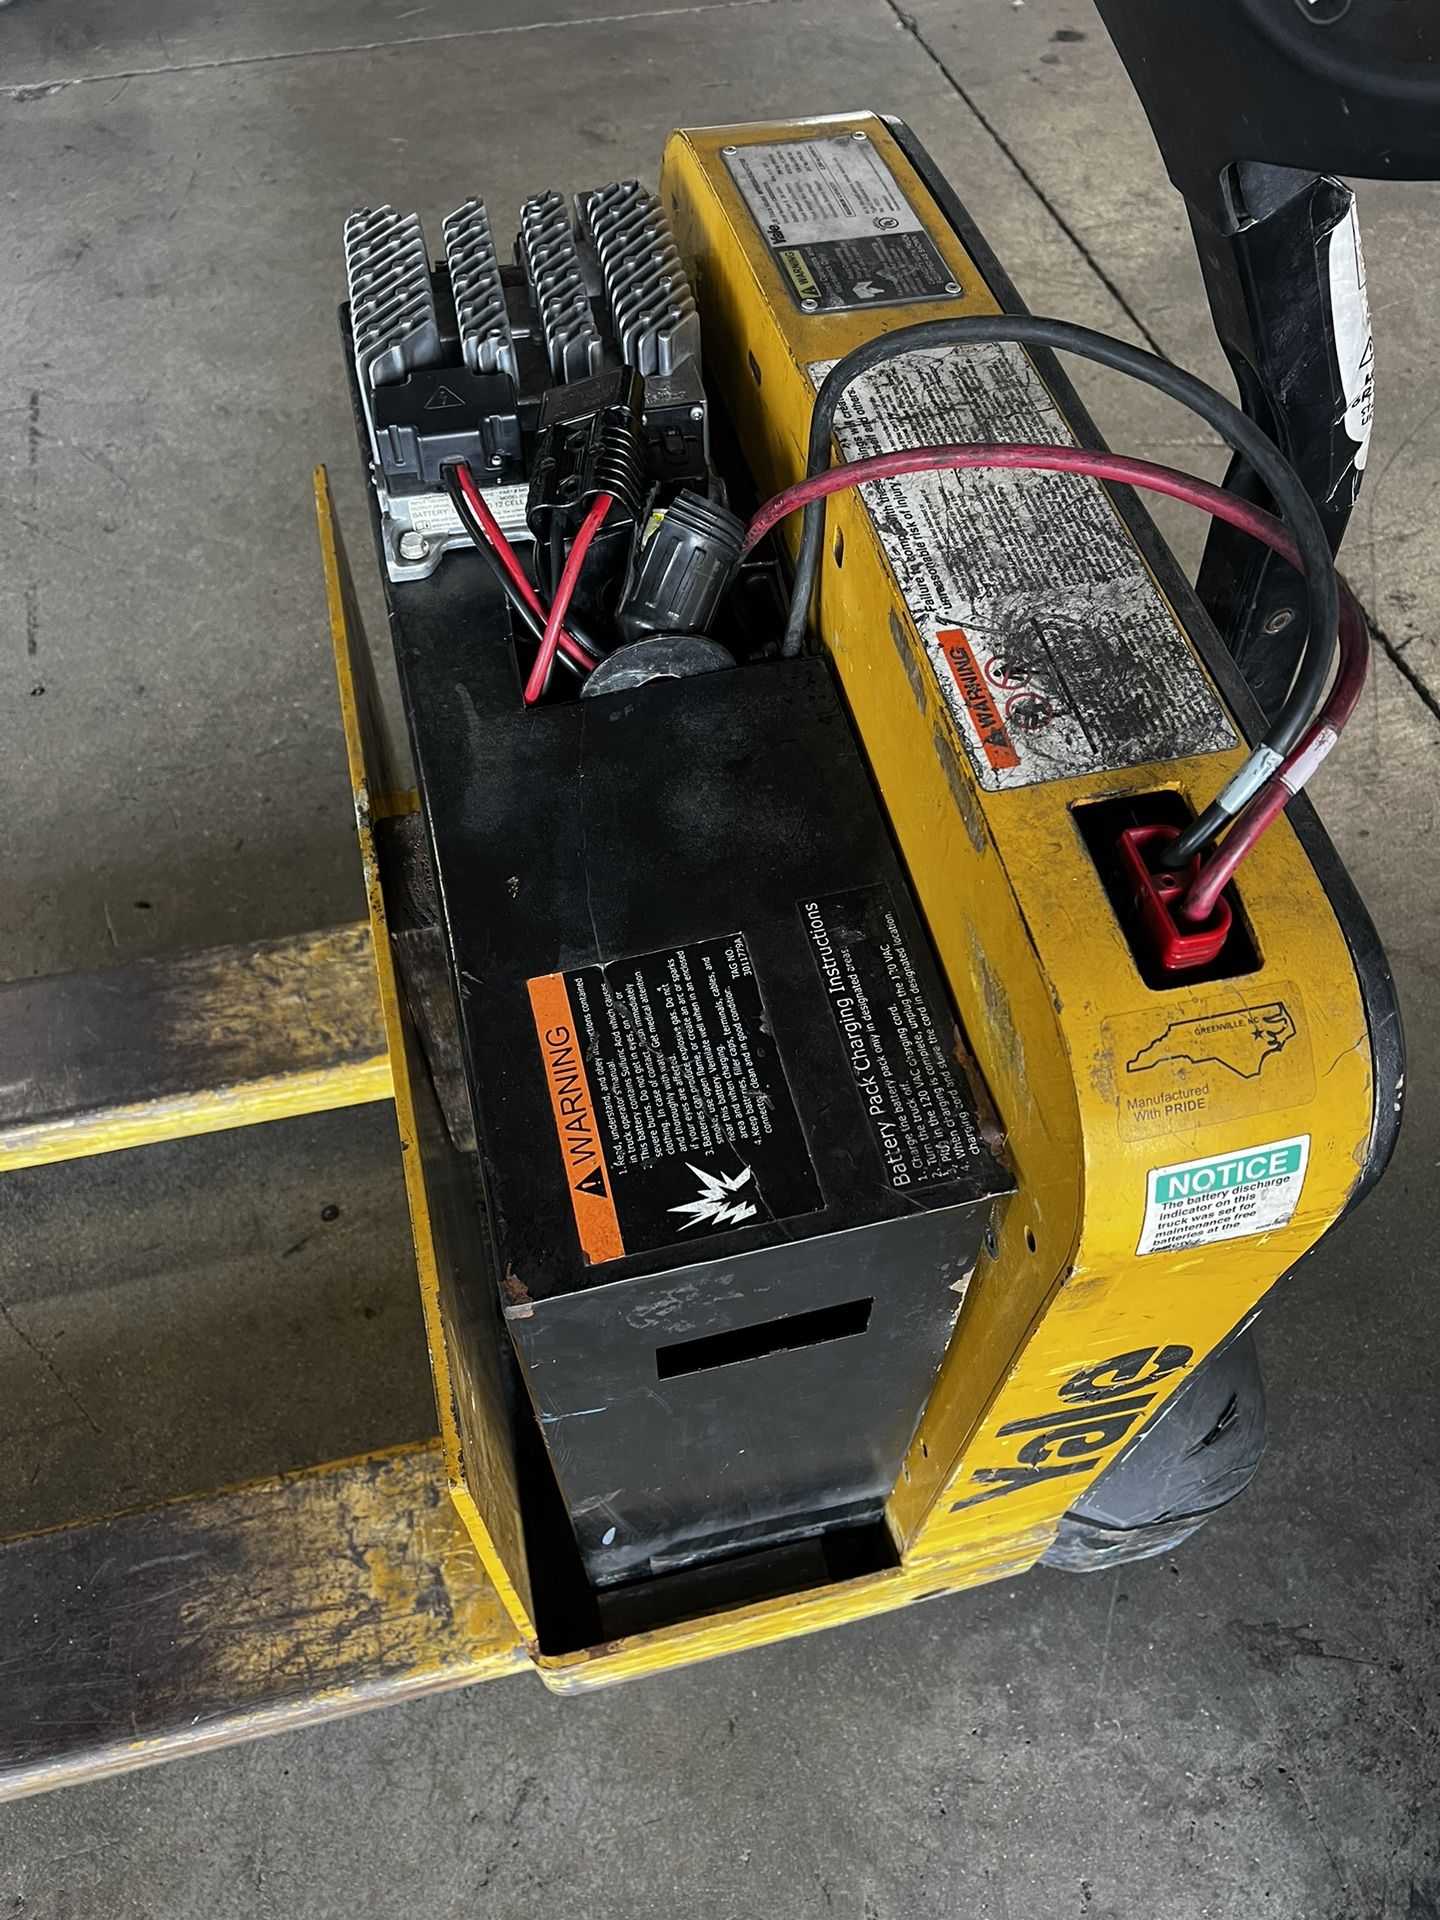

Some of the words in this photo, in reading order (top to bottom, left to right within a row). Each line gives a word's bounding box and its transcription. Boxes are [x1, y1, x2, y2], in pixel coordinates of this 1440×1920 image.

[763, 224, 787, 245] Yale
[783, 250, 809, 285] WARNING
[843, 386, 865, 415] others.
[856, 415, 874, 433] and
[886, 480, 911, 509] injury
[411, 507, 448, 519] BATTERY
[503, 496, 524, 507] CELL
[903, 520, 922, 540] risk
[911, 576, 937, 612] Failure
[947, 645, 998, 729] WARNING
[884, 911, 902, 946] location.
[733, 937, 752, 976] 3011779A
[804, 902, 845, 993] Instructions
[667, 958, 680, 982] sparks
[675, 950, 691, 980] enclosed
[701, 956, 712, 970] and
[728, 962, 740, 979] TAG
[894, 947, 919, 993] designated
[573, 977, 589, 1012] contained
[634, 970, 648, 1003] attention
[707, 971, 720, 996] cables,
[895, 982, 906, 997] the
[624, 983, 642, 1027] immediately
[676, 992, 686, 1004] arc
[847, 973, 871, 1020] designated
[605, 1008, 618, 1029] which
[641, 1004, 656, 1032] medical
[669, 1009, 681, 1025] gas.
[691, 1001, 702, 1022] when
[714, 998, 731, 1035] terminals,
[887, 1003, 902, 1025] cord.
[901, 998, 918, 1029] unplug
[916, 1006, 931, 1026] cord
[610, 1030, 622, 1046] Acid
[683, 1016, 695, 1040] create
[695, 1022, 707, 1038] well
[732, 1022, 747, 1041] good
[836, 997, 870, 1074] Charging
[1193, 1017, 1247, 1037] GREENVILLE,
[1247, 1015, 1260, 1025] NC
[625, 1030, 636, 1050] eyes,
[650, 1033, 660, 1048] Get
[673, 1026, 688, 1060] explosive
[726, 1036, 737, 1056] caps,
[594, 1057, 604, 1075] obey
[616, 1048, 630, 1076] Sulfuric
[631, 1060, 644, 1073] get
[692, 1051, 705, 1076] flame,
[701, 1039, 716, 1073] Ventilate
[716, 1043, 731, 1079] charging.
[731, 1058, 742, 1075] filler
[740, 1051, 753, 1066] and
[876, 1054, 893, 1077] pack
[596, 1076, 608, 1091] and
[635, 1074, 645, 1088] not
[660, 1073, 671, 1090] with
[700, 1077, 711, 1096] open
[712, 1074, 726, 1104] battery.
[747, 1067, 759, 1088] clean
[898, 1080, 912, 1095] off.
[909, 1068, 924, 1088] VAC
[545, 1025, 595, 1165] WARNING
[624, 1077, 638, 1109] contains
[652, 1089, 663, 1107] case
[677, 1087, 687, 1100] are
[726, 1080, 737, 1102] when
[859, 1075, 884, 1115] Pack
[885, 1079, 903, 1113] battery
[917, 1090, 932, 1107] 120
[947, 1089, 963, 1108] cord
[1126, 1082, 1209, 1111] Manufactured
[601, 1092, 619, 1140] understand,
[613, 1089, 630, 1129] operator's
[643, 1102, 655, 1128] burns.
[665, 1092, 683, 1134] thoroughly
[681, 1102, 692, 1121] eyes
[705, 1098, 715, 1113] use
[720, 1105, 730, 1121] this
[730, 1103, 742, 1118] and
[905, 1097, 922, 1122] truck
[926, 1109, 939, 1126] the
[1133, 1107, 1161, 1124] With
[1164, 1097, 1206, 1117] PRIDE
[633, 1111, 646, 1141] battery
[660, 1119, 675, 1154] clothing.
[686, 1123, 699, 1141] your
[696, 1110, 712, 1147] Batteries
[710, 1114, 724, 1144] smoke,
[724, 1123, 736, 1142] near
[737, 1120, 748, 1138] area
[748, 1115, 760, 1136] Keep
[916, 1124, 929, 1141] the
[955, 1111, 980, 1154] charging
[623, 1130, 635, 1153] truck
[639, 1142, 649, 1161] This
[649, 1129, 663, 1157] severe
[675, 1136, 687, 1151] and
[877, 1121, 910, 1186] Battery
[904, 1133, 923, 1168] Charge
[949, 1129, 965, 1159] When
[923, 1142, 937, 1166] Turn
[1166, 1148, 1291, 1199] NOTICE
[1161, 1200, 1183, 1210] The
[1186, 1189, 1229, 1205] battery
[1231, 1175, 1290, 1194] discharge
[1157, 1217, 1187, 1229] truck
[1191, 1212, 1214, 1221] was
[1217, 1205, 1236, 1216] set
[1239, 1202, 1256, 1211] for
[1159, 1203, 1212, 1220] indicator
[1215, 1199, 1230, 1207] on
[1234, 1193, 1255, 1203] this
[1152, 1230, 1203, 1246] batteries
[1206, 1225, 1218, 1233] at
[1221, 1221, 1240, 1230] the
[1155, 1216, 1231, 1238] maintenance
[1233, 1210, 1256, 1220] free
[949, 1344, 1194, 1514] Yale
